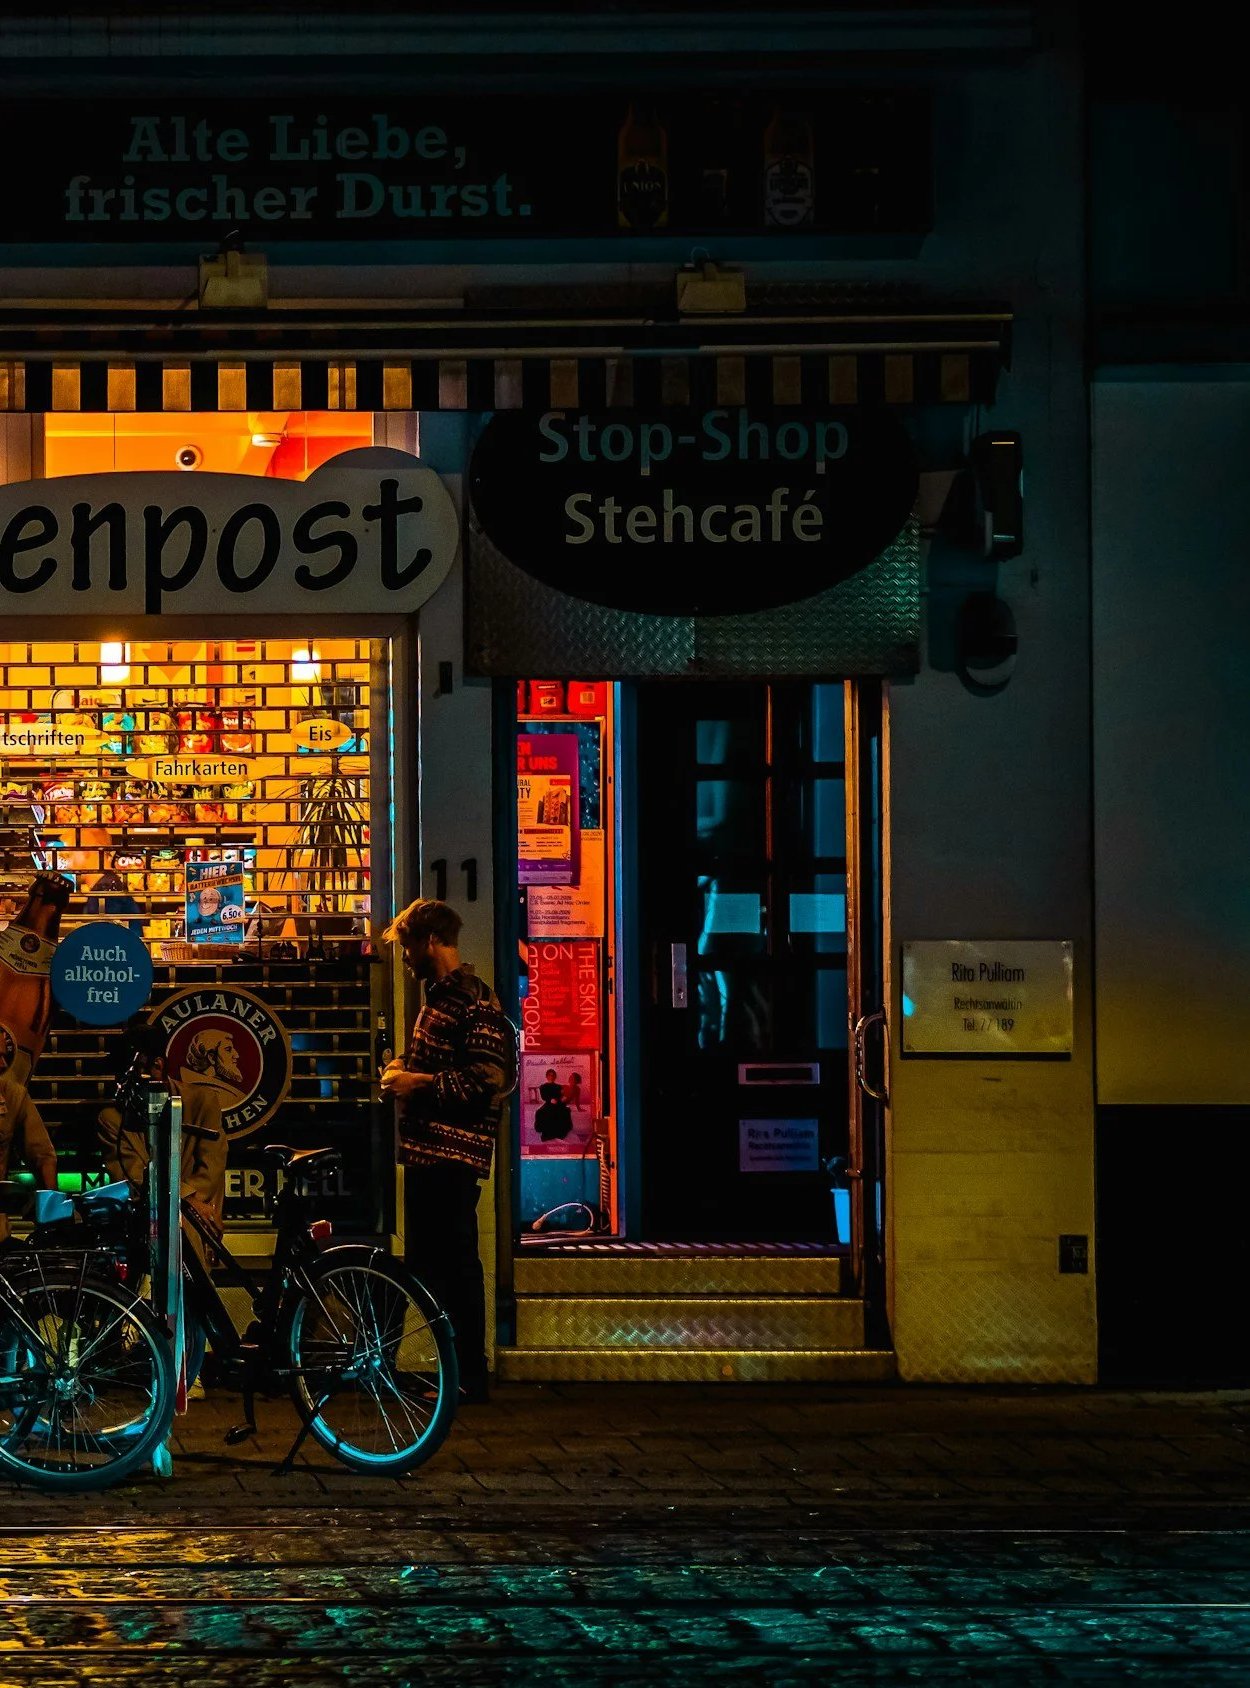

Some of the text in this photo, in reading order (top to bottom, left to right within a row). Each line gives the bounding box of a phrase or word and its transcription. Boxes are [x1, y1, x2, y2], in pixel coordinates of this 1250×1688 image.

[123, 112, 468, 170] Alte Liebe,
[63, 170, 535, 222] frischer Durst.
[537, 411, 850, 477] Stop-Shop
[563, 486, 825, 545] Stehcafé
[308, 726, 332, 741] Eis
[154, 759, 249, 776] Fahrkarten
[199, 864, 228, 880] HIER
[431, 858, 477, 902] 11
[80, 945, 128, 962] Auch
[542, 943, 573, 961] ON
[64, 965, 141, 983] alkohol-
[951, 962, 975, 982] Rita
[578, 943, 597, 1026] THE SKIN
[86, 986, 120, 1004] frei
[160, 992, 277, 1047] AULANER
